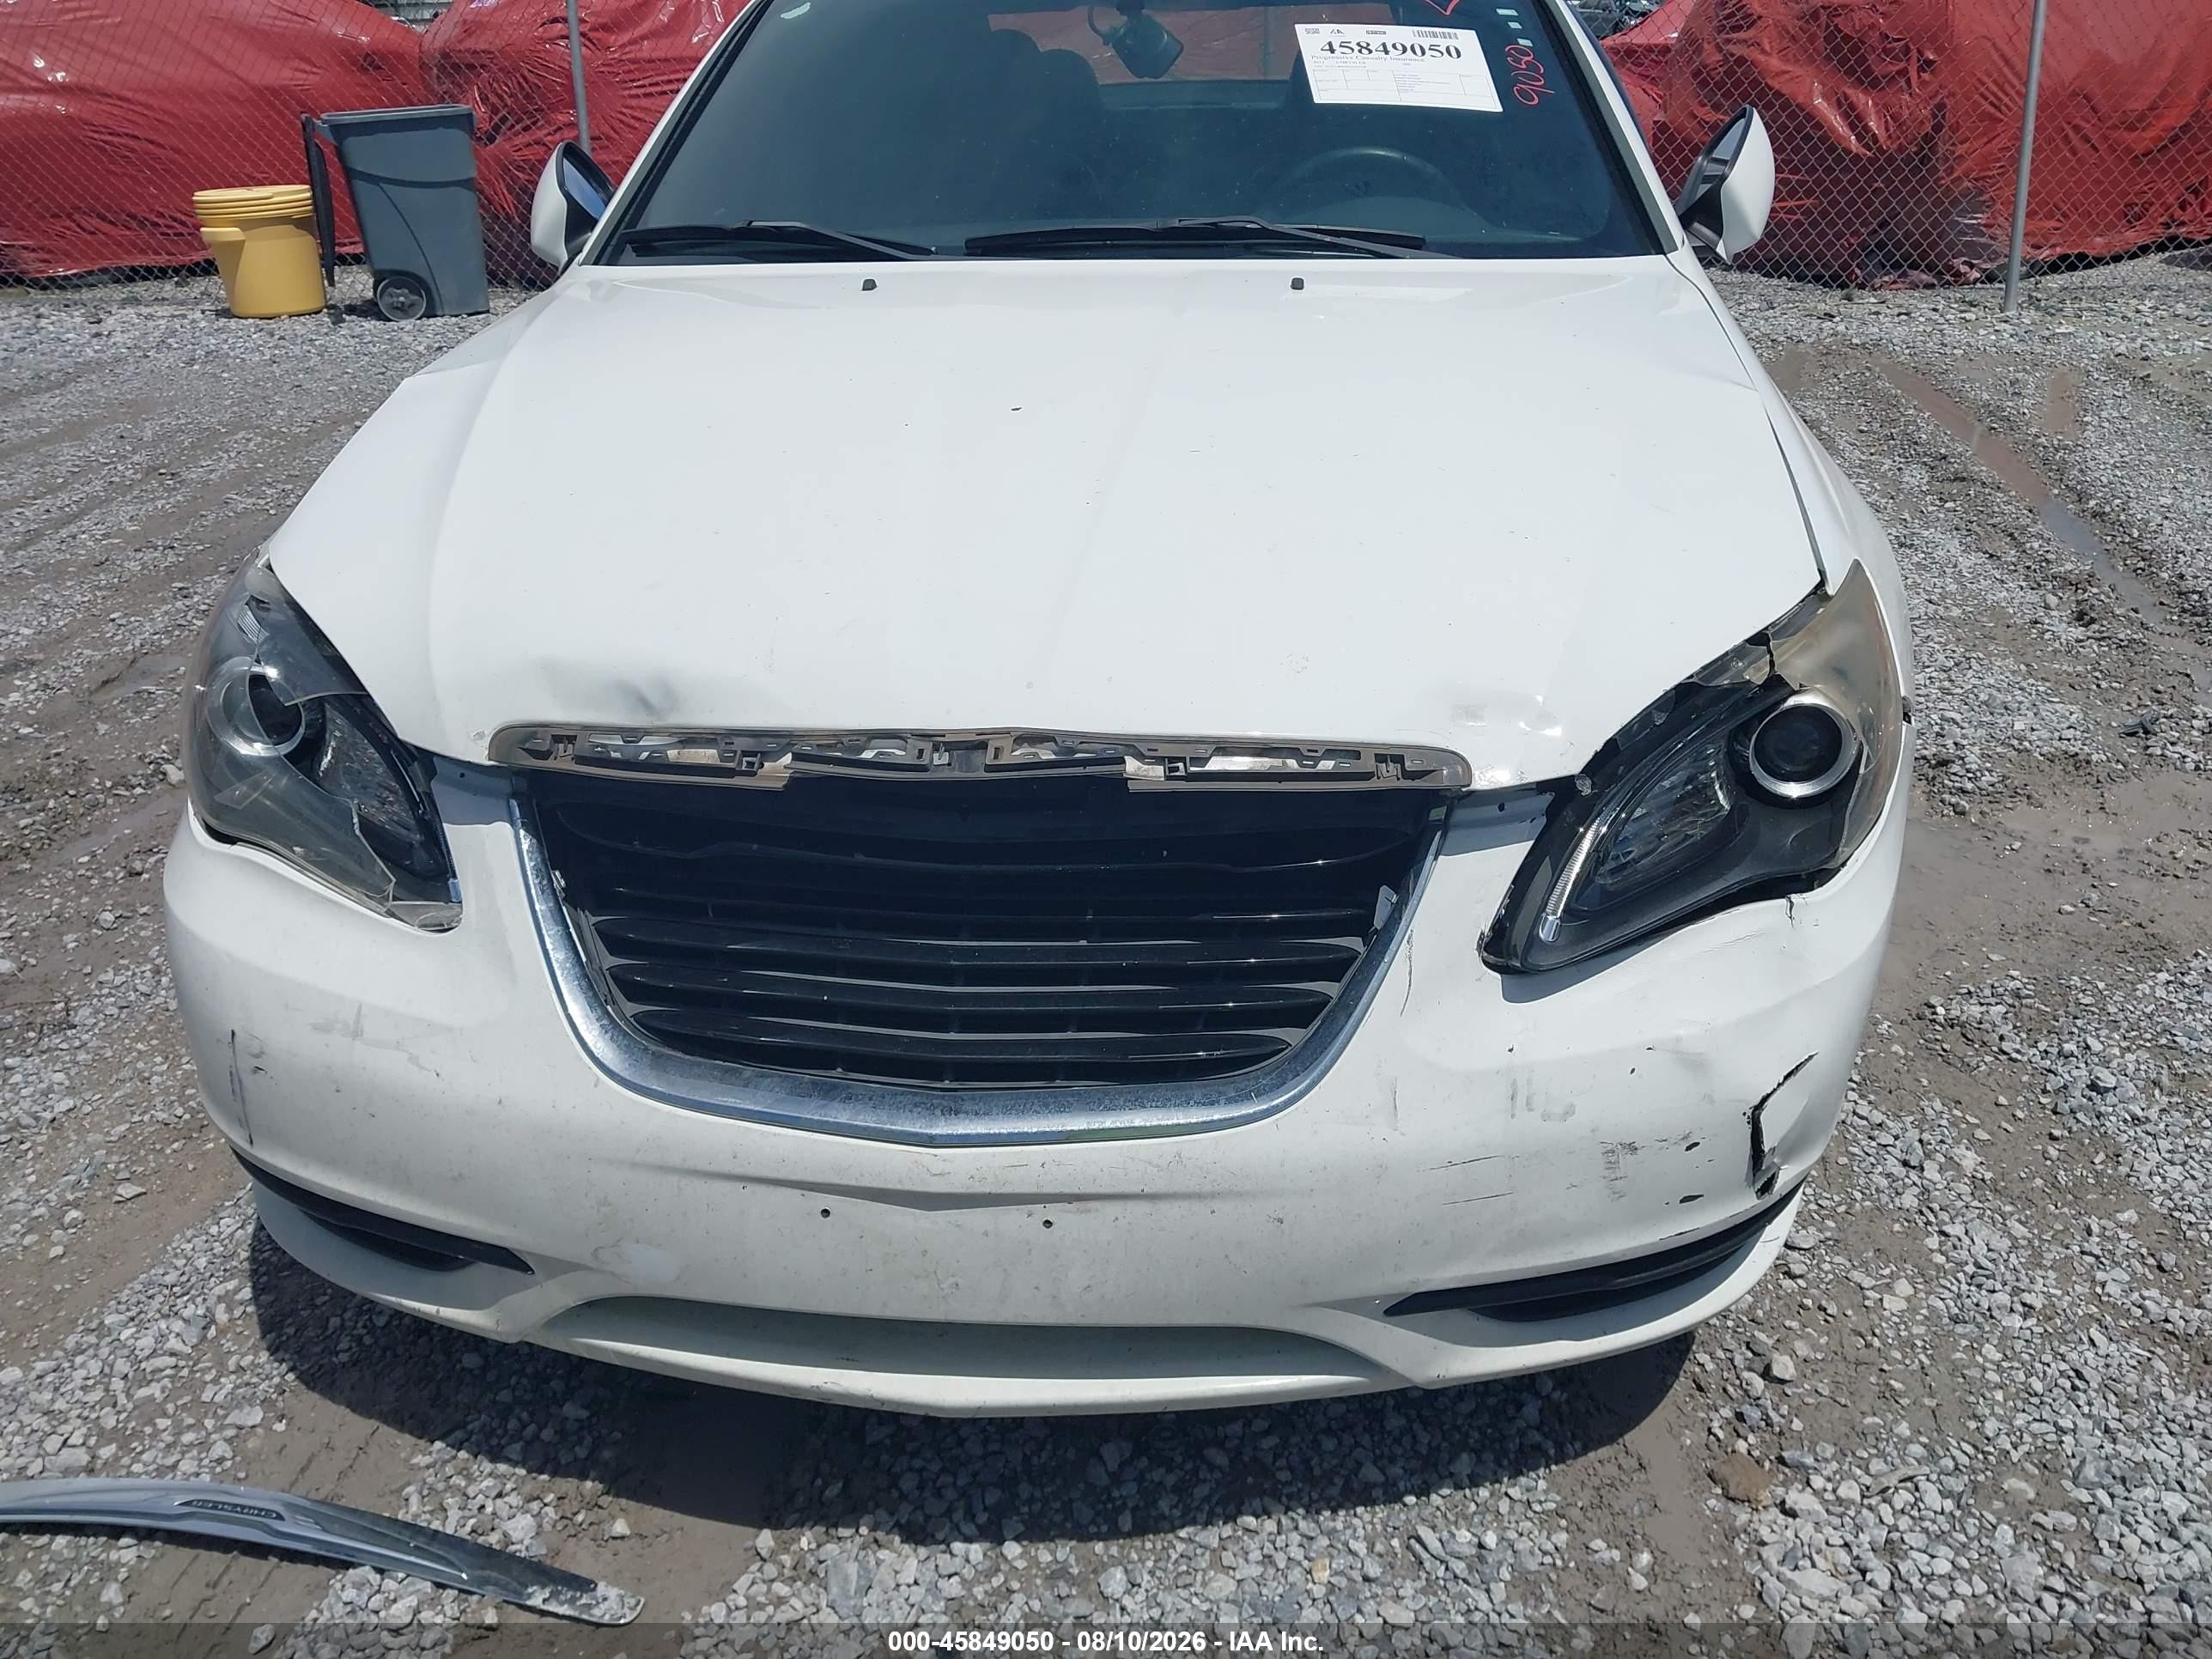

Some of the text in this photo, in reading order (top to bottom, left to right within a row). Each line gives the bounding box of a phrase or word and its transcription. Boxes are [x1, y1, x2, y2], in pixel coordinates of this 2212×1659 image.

[1320, 40, 1462, 59] 45849050
[1505, 45, 1556, 106] 9050
[191, 1500, 276, 1517] CHRYSLER
